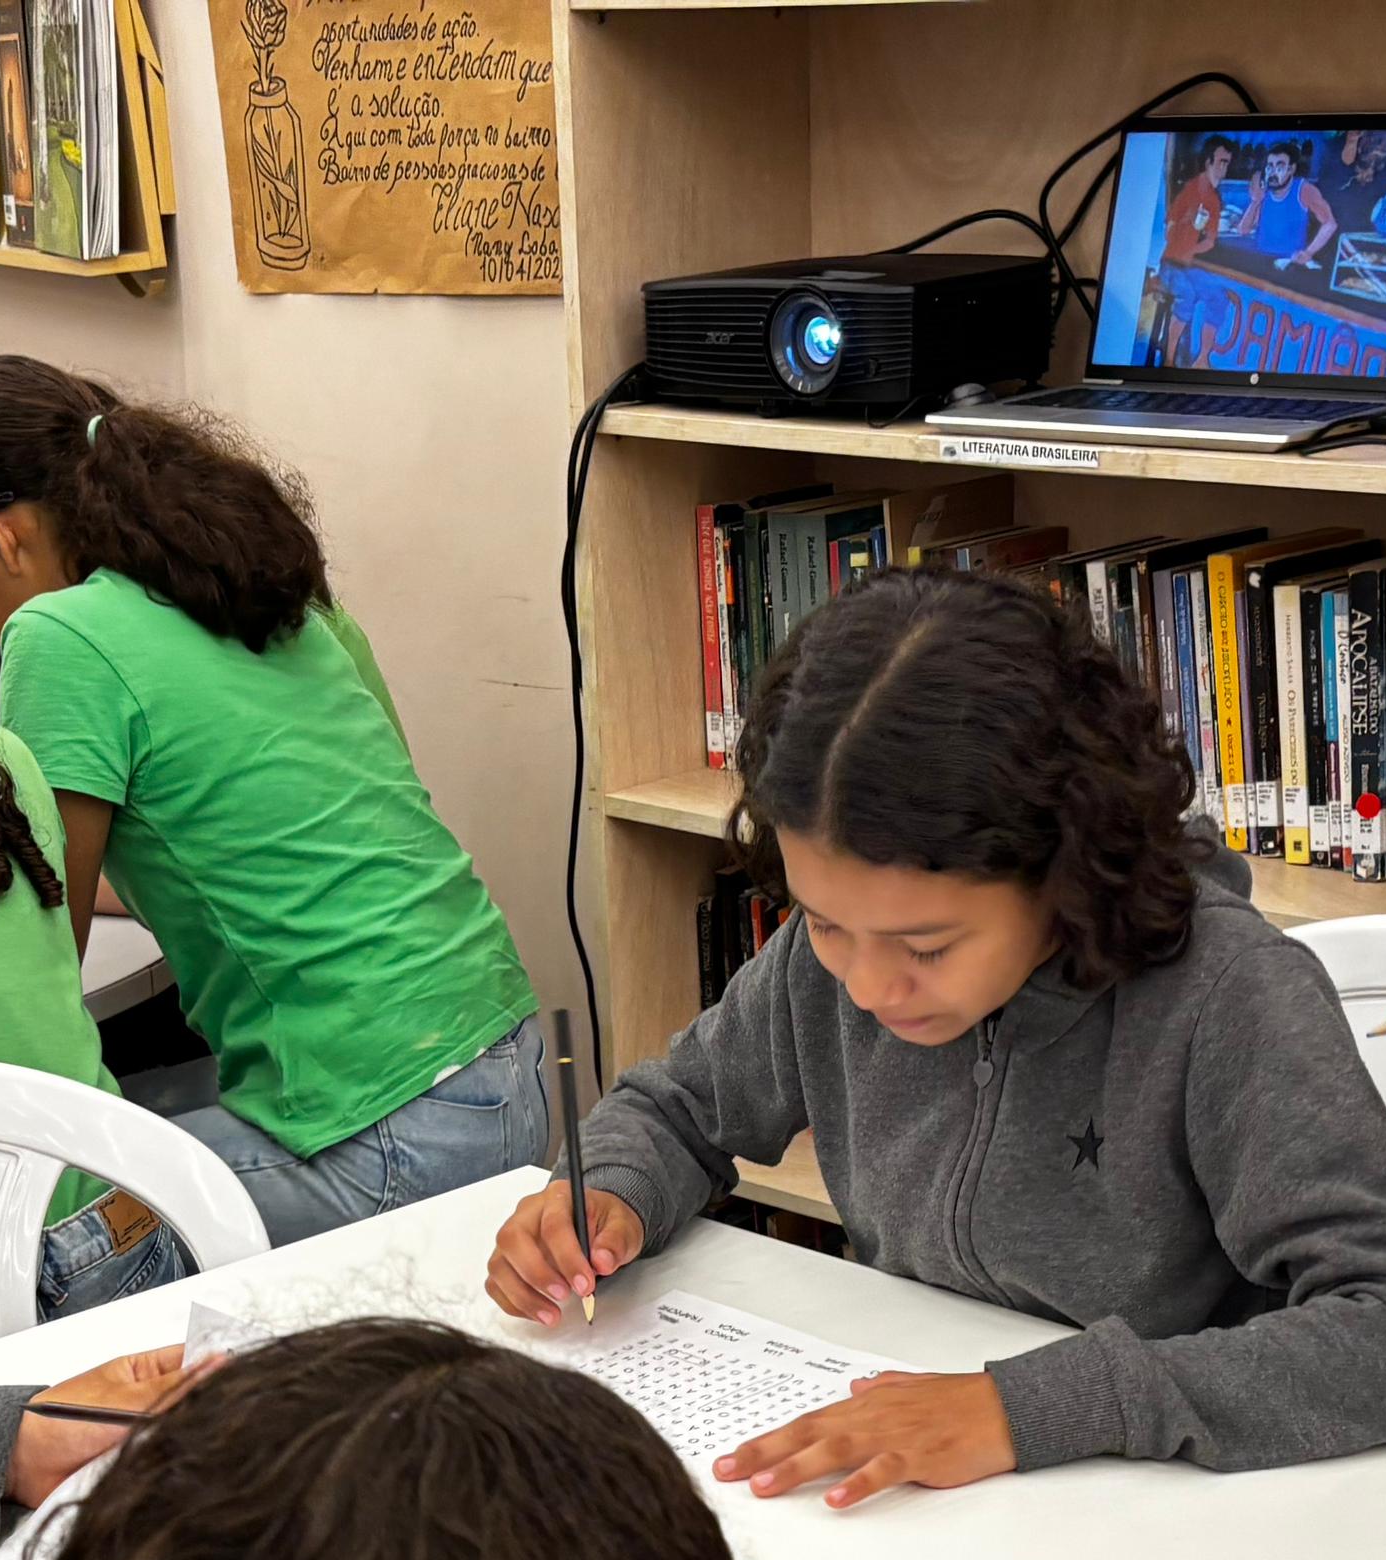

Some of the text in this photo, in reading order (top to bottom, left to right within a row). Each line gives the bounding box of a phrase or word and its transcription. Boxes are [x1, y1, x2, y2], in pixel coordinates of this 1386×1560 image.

[421, 12, 479, 54] de ação.
[313, 39, 552, 102] Venham e entendam que
[351, 85, 444, 127] a solução.
[371, 118, 550, 148] com toda no bairro
[374, 151, 389, 179] de
[389, 160, 455, 193] pessoas
[530, 154, 545, 181] de
[963, 442, 1098, 461] LITERATURA BRASILEIRA
[779, 534, 789, 602] Rafael Gomes
[807, 536, 818, 605] Rafael Gomes
[1350, 609, 1372, 736] APOCALIPSE
